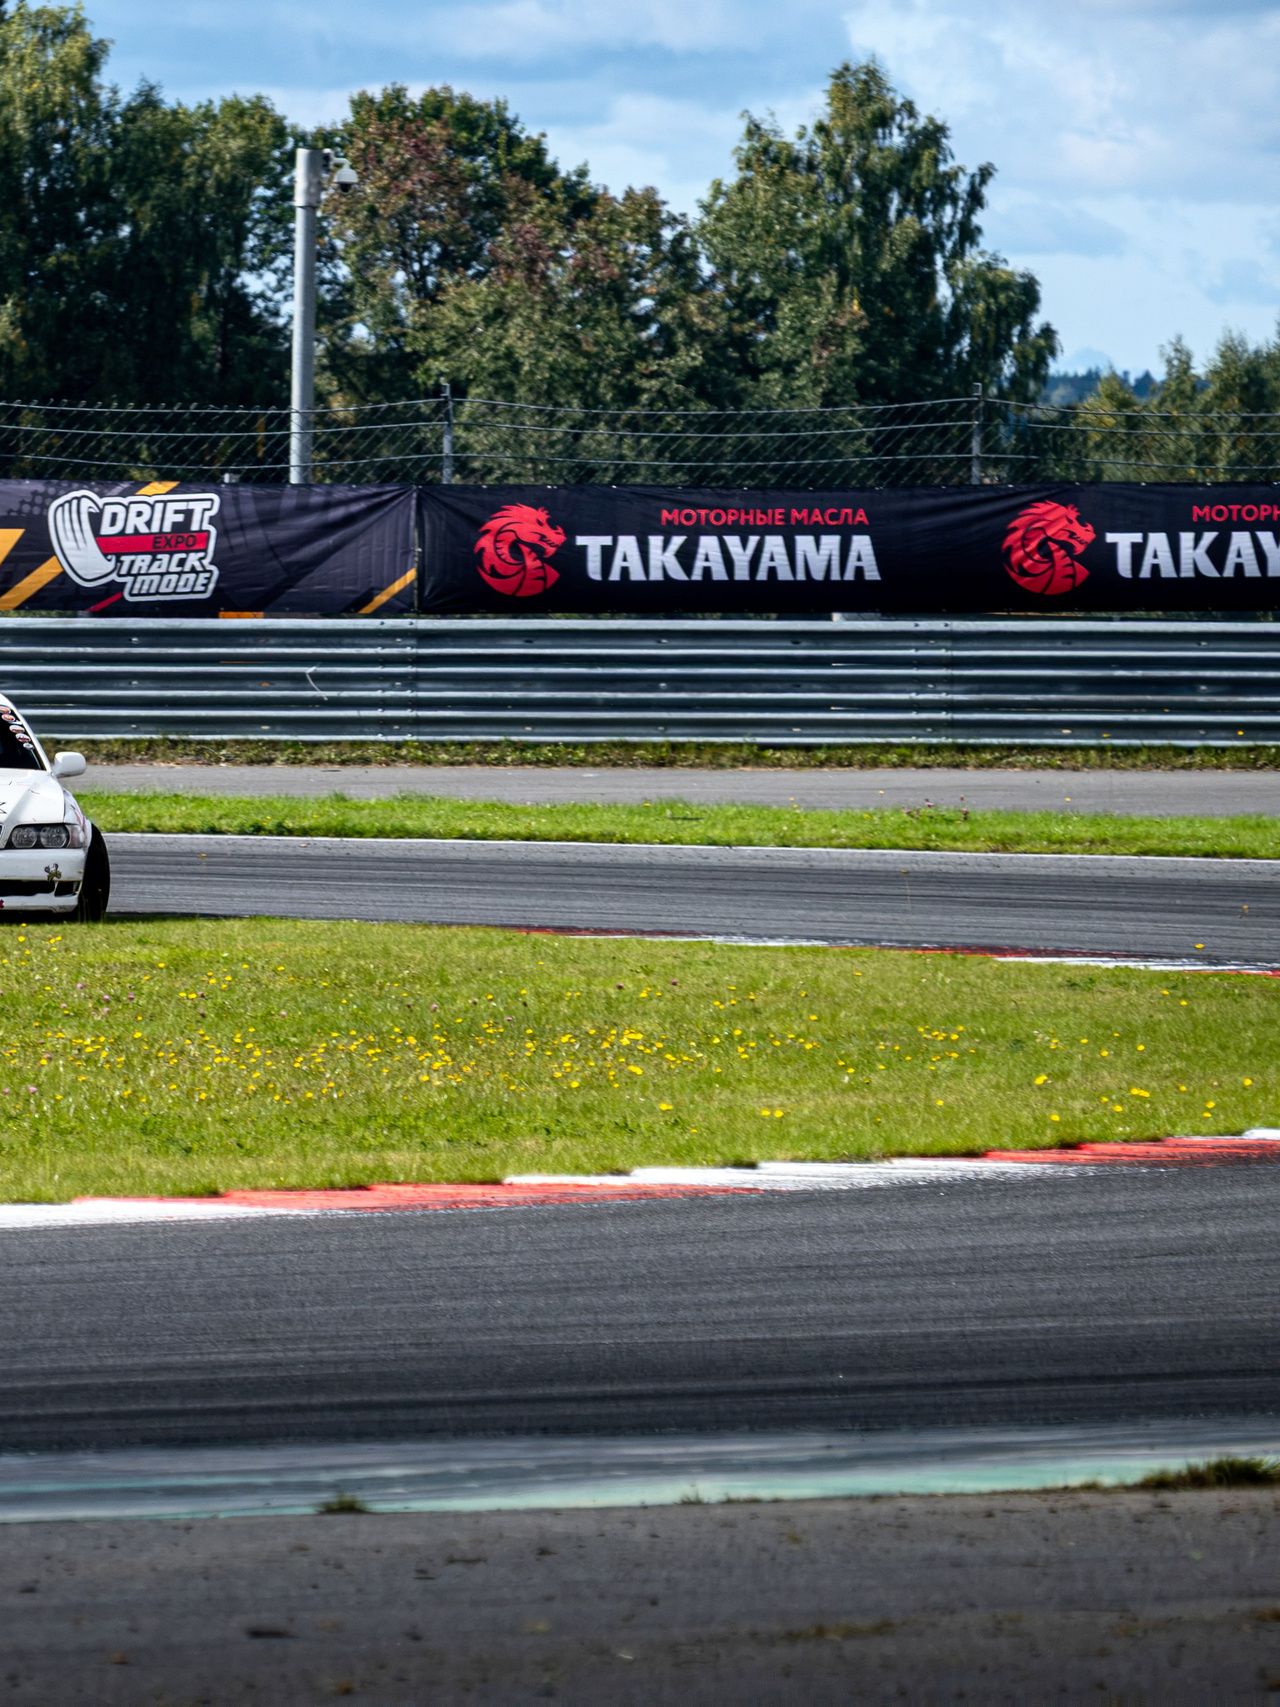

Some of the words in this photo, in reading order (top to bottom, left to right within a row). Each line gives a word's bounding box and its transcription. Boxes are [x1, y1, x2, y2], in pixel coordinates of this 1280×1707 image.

[100, 499, 213, 535] DRIFT
[660, 508, 785, 527] МОТОРНЫЕ
[790, 508, 870, 526] МАСЛА
[152, 535, 198, 550] EXPO
[119, 551, 208, 575] TRACK
[575, 534, 882, 582] TAKAYAMA
[132, 573, 211, 595] MODE
